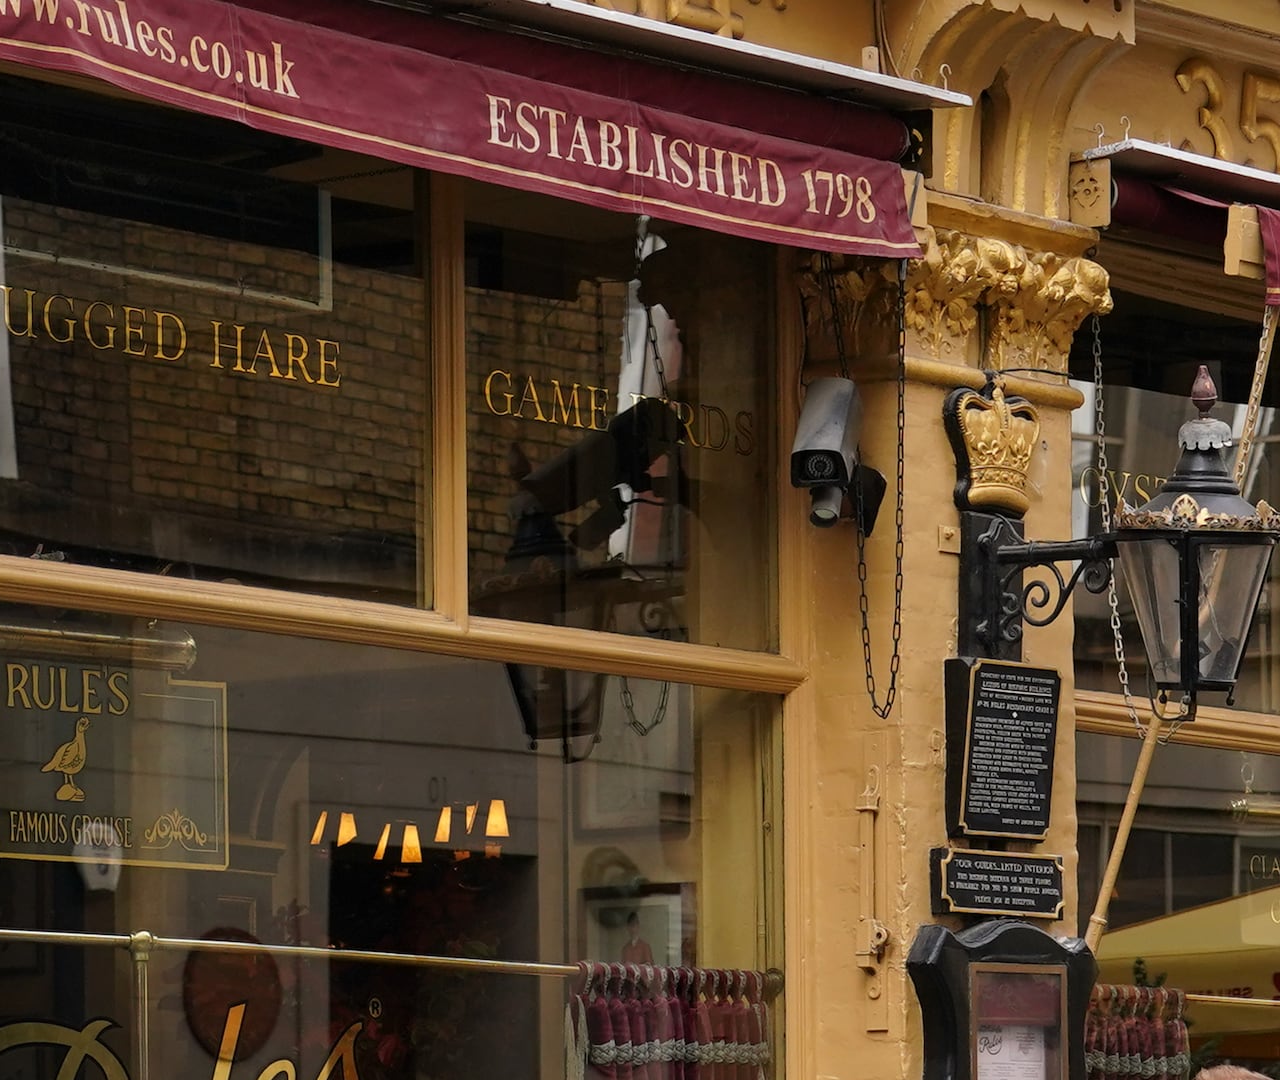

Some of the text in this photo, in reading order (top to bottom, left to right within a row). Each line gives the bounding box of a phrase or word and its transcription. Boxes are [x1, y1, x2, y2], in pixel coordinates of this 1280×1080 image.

[485, 94, 877, 226] ESTABLISHED 1798
[209, 319, 342, 389] HARE
[484, 369, 754, 457] GAME RDS
[6, 662, 130, 716] RULE'S
[9, 810, 134, 849] FAMOUS GROUSE
